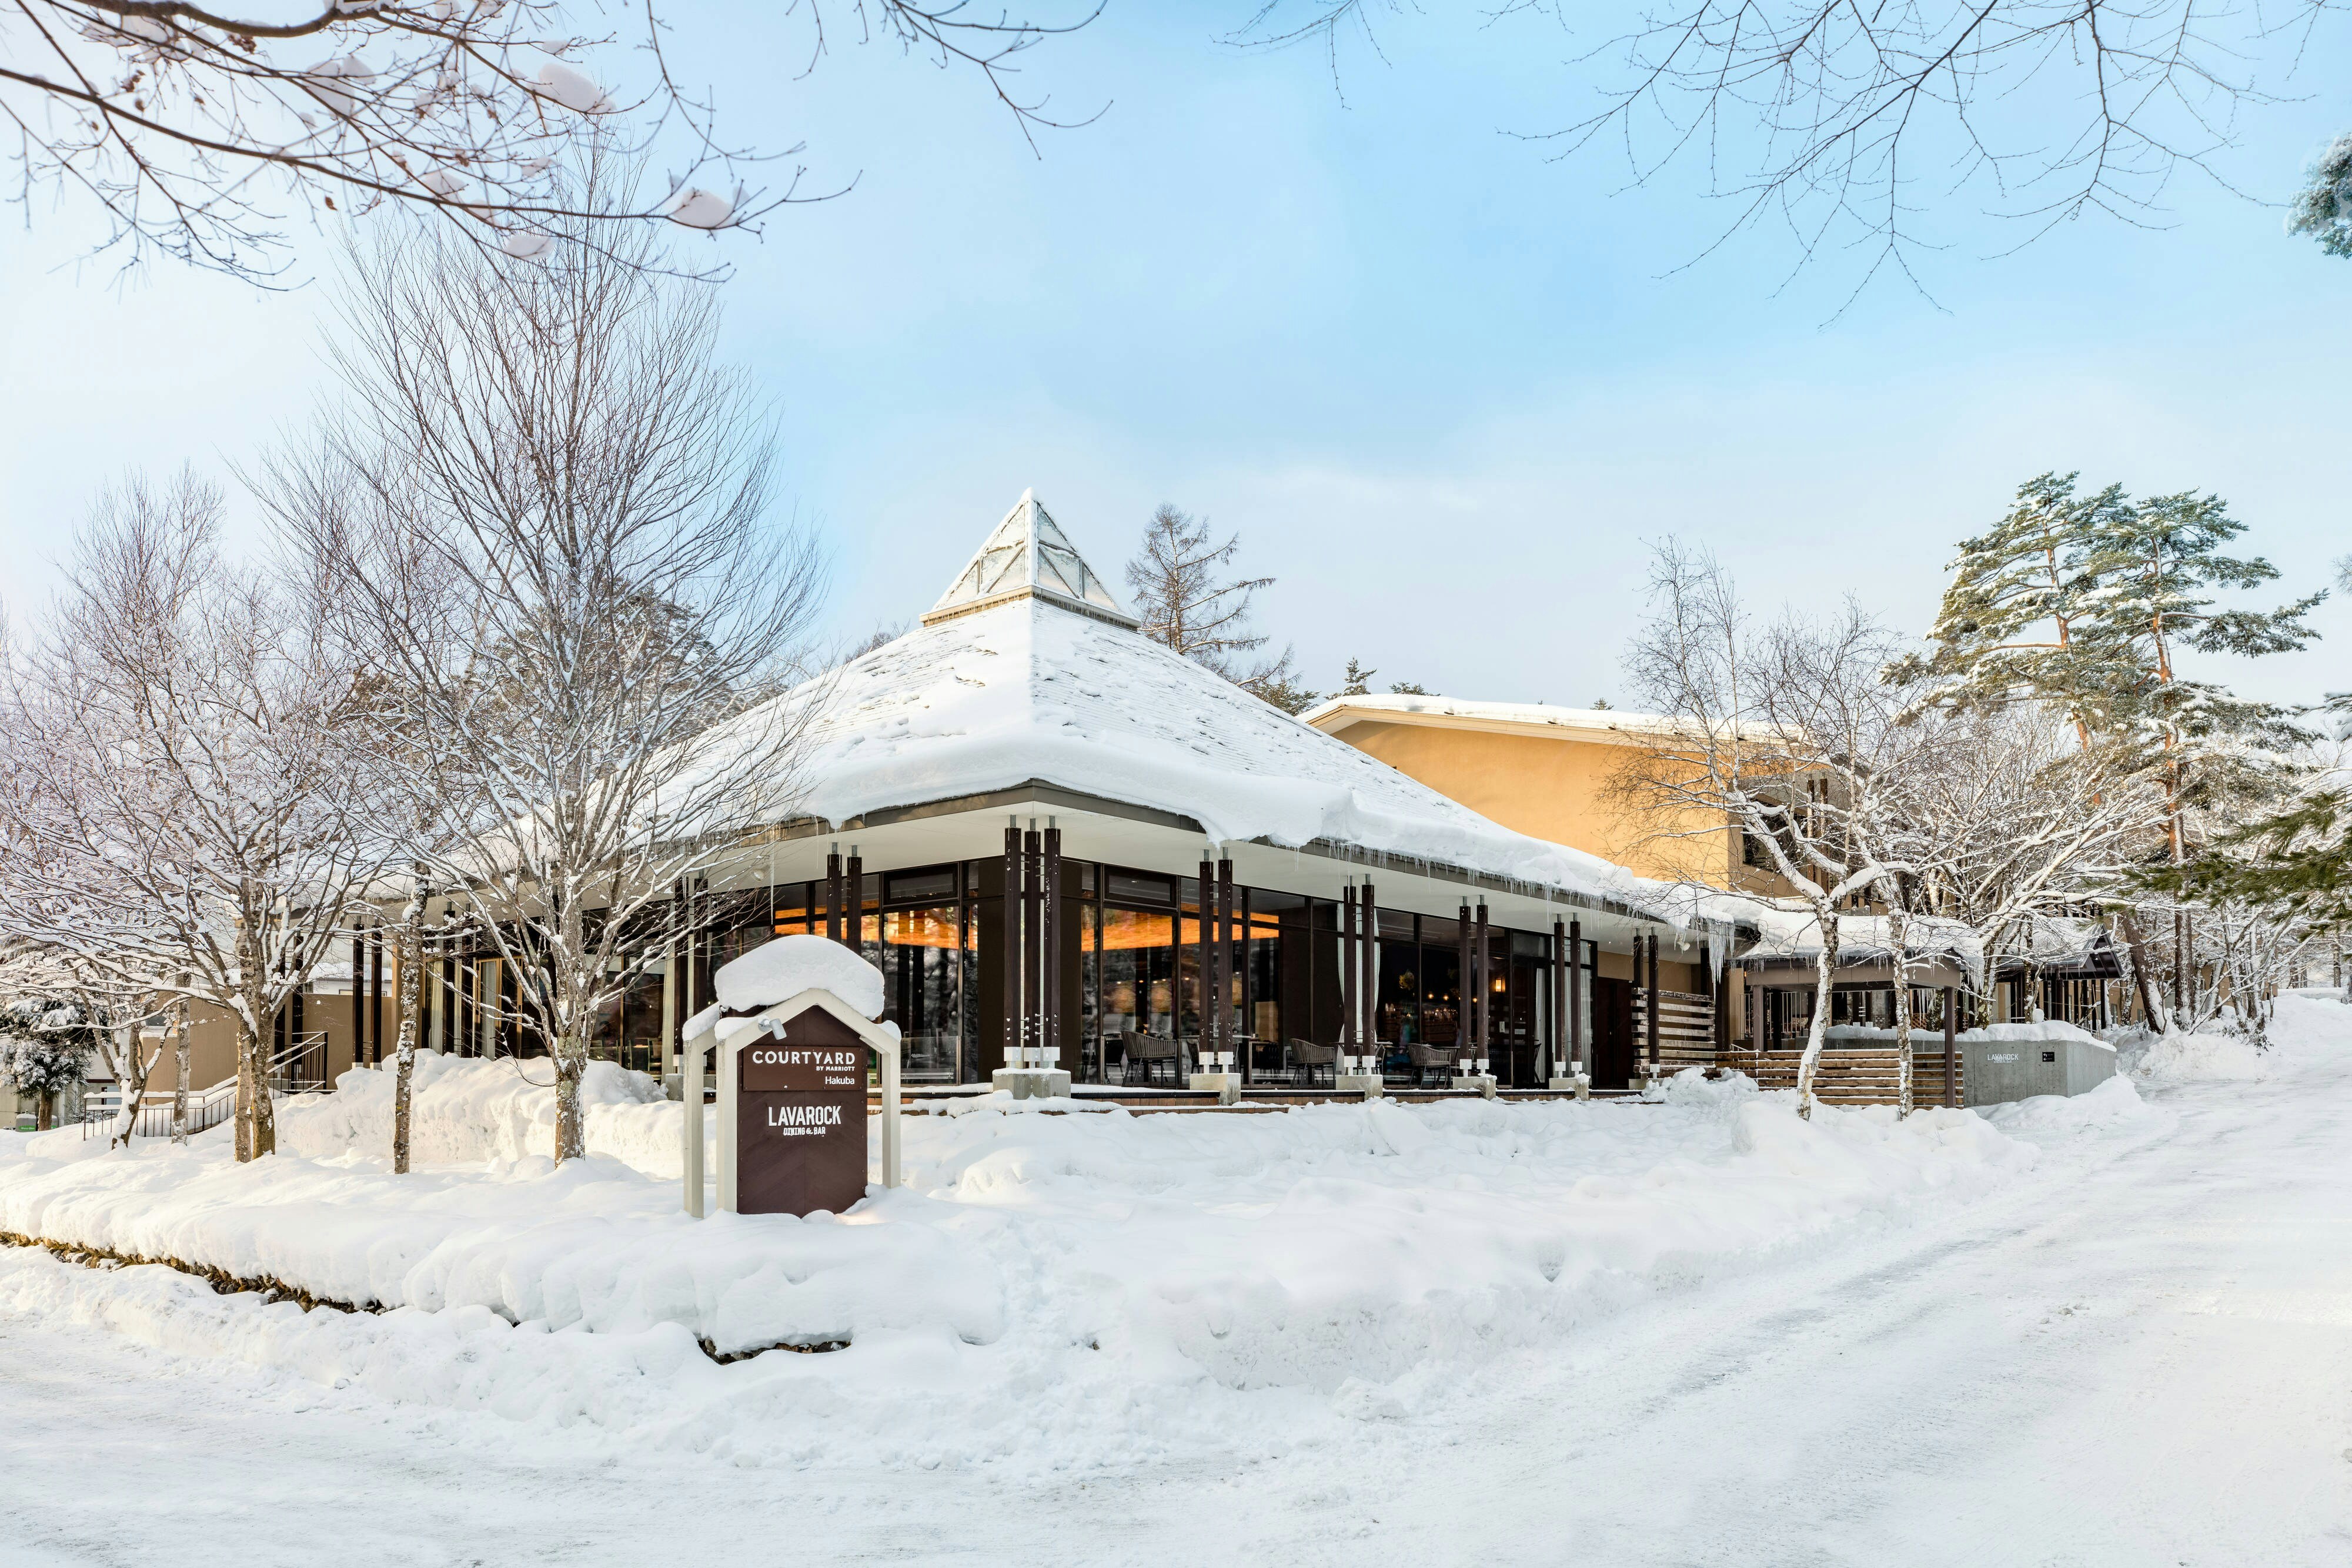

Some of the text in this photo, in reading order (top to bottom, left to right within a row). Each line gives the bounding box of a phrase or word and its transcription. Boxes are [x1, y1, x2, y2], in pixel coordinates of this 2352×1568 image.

[752, 1051, 856, 1065] COURTYARD
[825, 1076, 855, 1085] Hakuba
[768, 1106, 841, 1126] LAVAROCK
[783, 1127, 806, 1136] DINING
[813, 1126, 826, 1135] BAR
